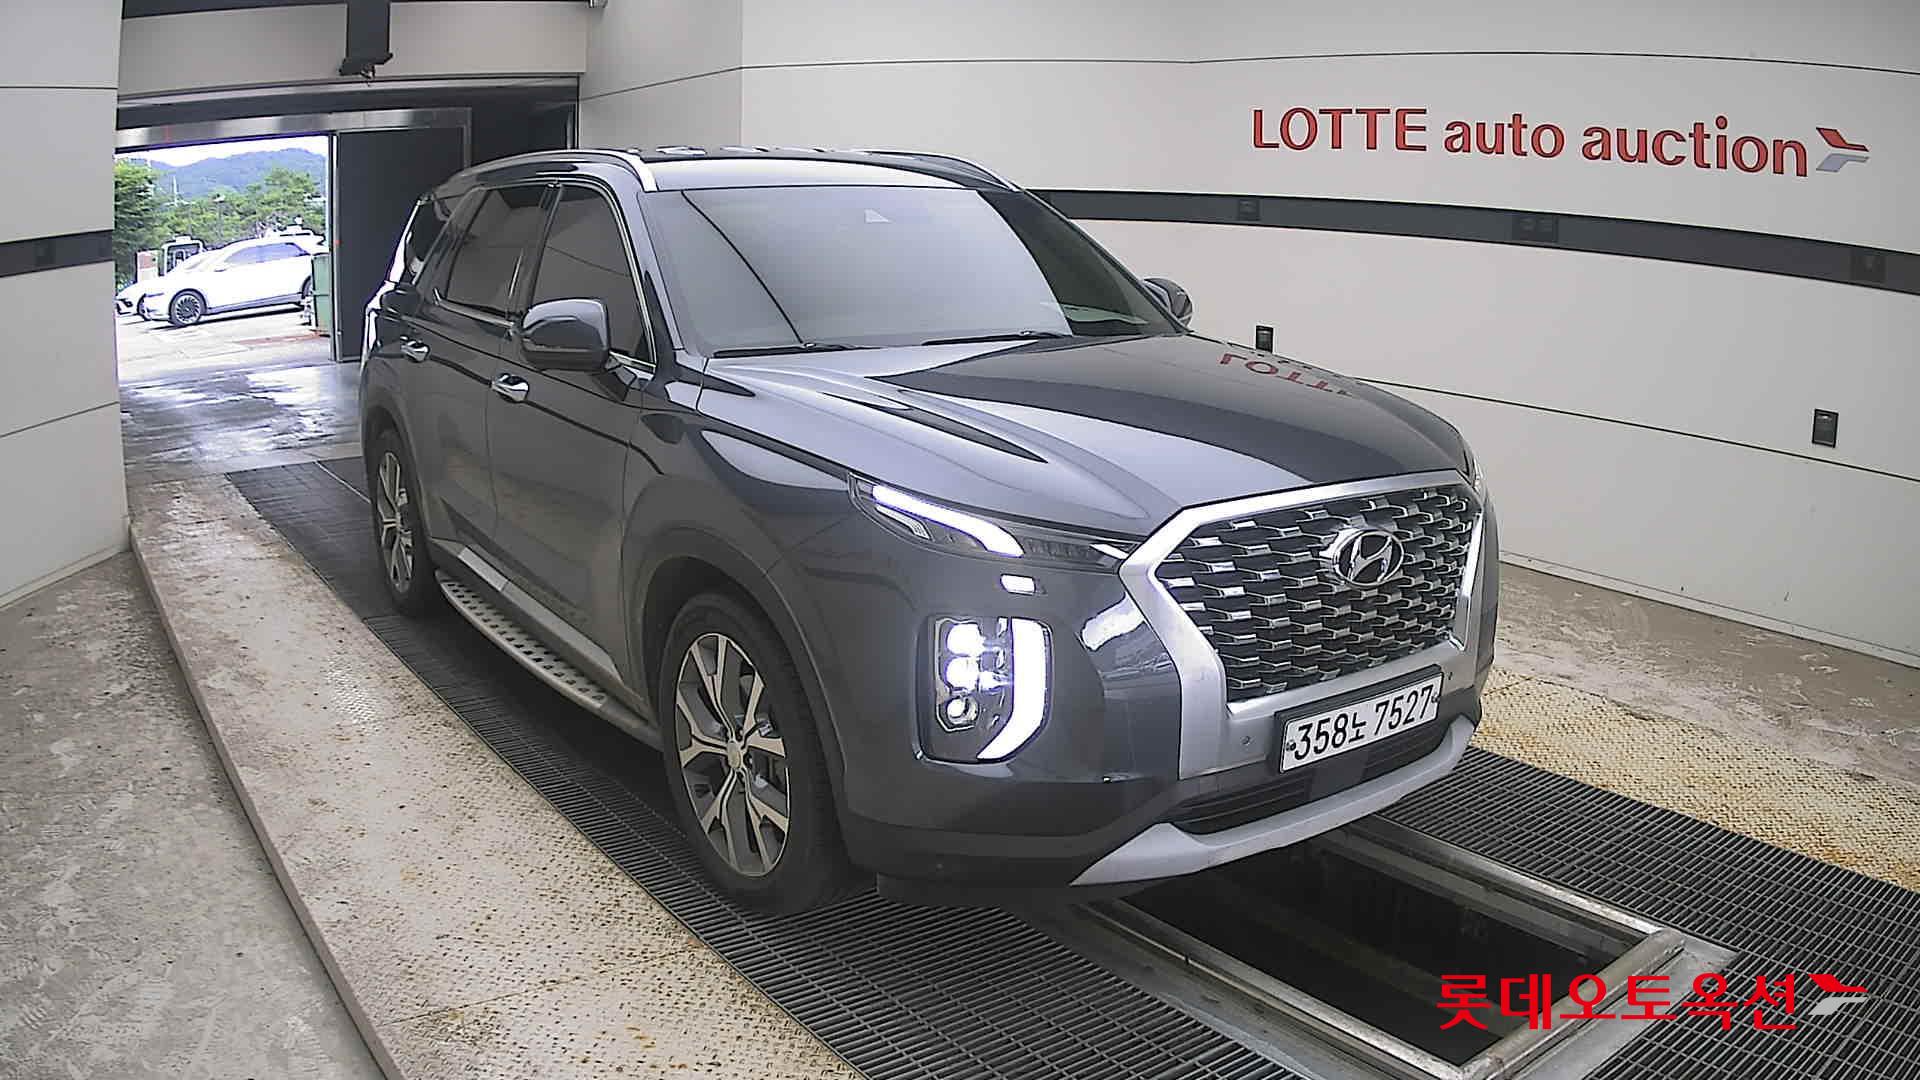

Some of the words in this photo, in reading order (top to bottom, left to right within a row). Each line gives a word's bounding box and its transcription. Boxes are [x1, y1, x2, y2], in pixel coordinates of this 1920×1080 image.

[1252, 107, 1428, 152] LOTTE
[1443, 113, 1567, 159] auto
[1581, 115, 1810, 178] auction
[1293, 711, 1367, 761] 358노
[1374, 684, 1434, 736] 7527
